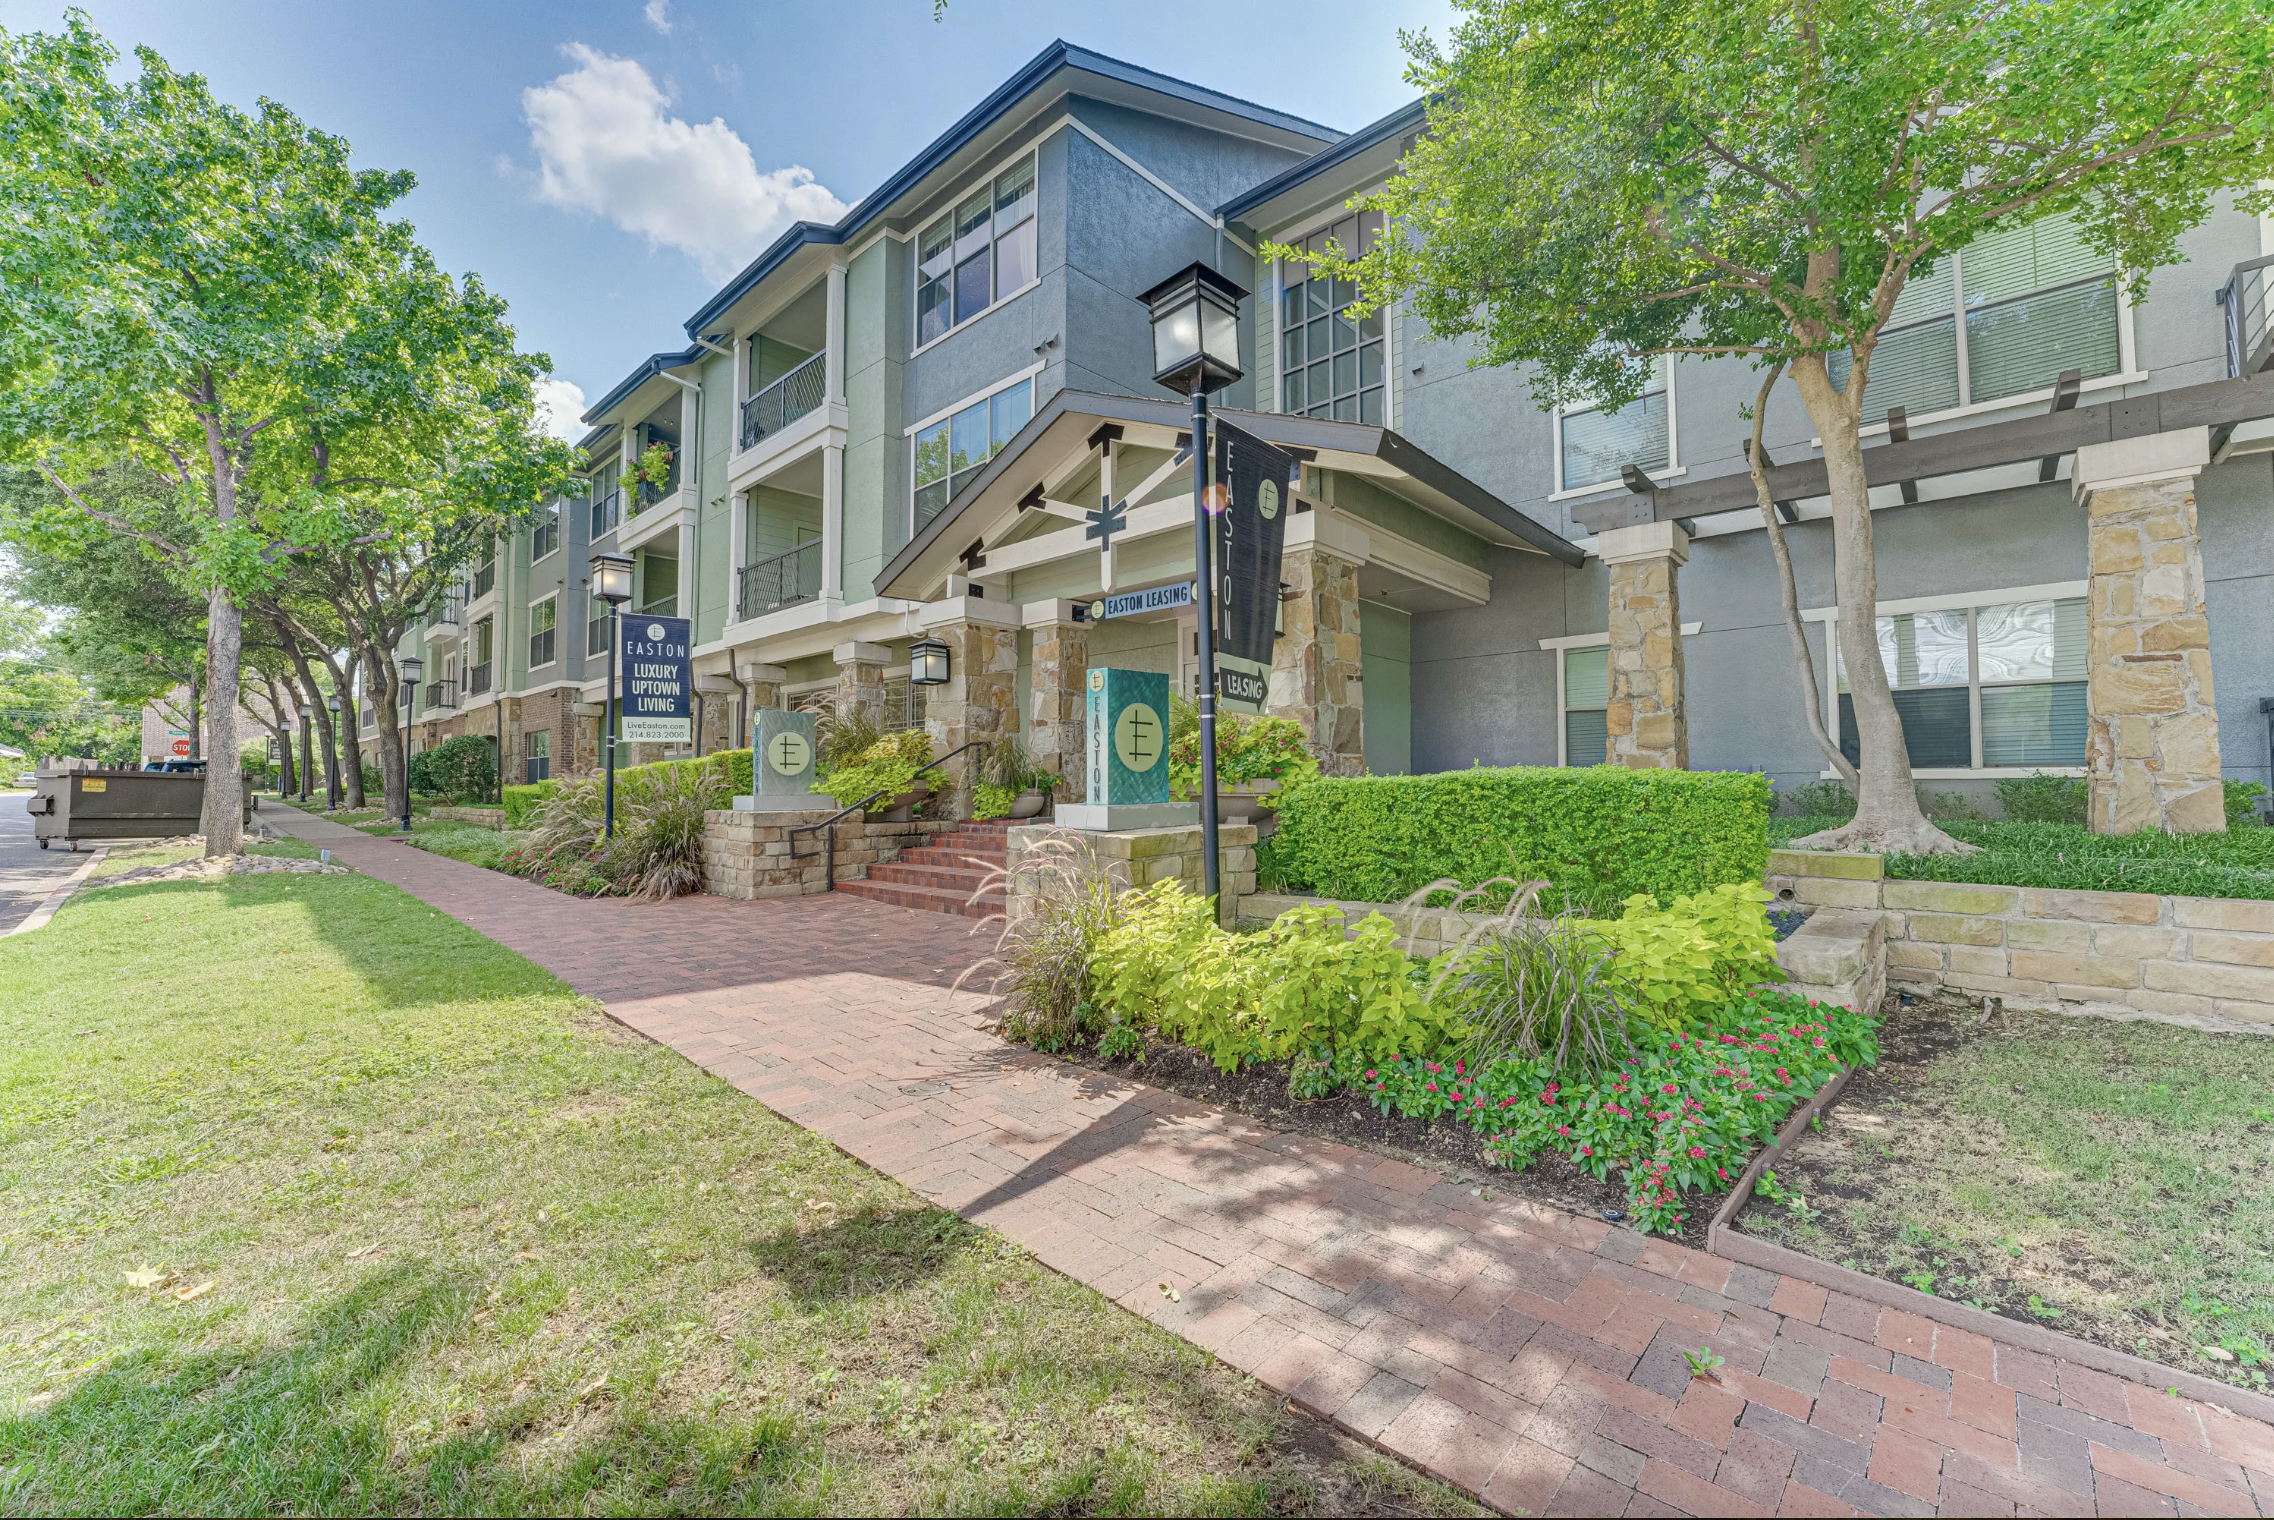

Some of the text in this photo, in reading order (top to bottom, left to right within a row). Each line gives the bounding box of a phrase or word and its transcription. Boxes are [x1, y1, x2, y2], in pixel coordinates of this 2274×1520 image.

[1224, 440, 1234, 641] EASTON
[1108, 586, 1188, 615] EASTON LEASING
[627, 641, 685, 657] EASTON
[634, 663, 679, 679] LUXURY
[632, 680, 680, 696] UPTOWN
[1227, 674, 1263, 699] LEASING
[638, 697, 675, 712] LIVING
[627, 721, 686, 730] LiveEaston.com
[629, 731, 685, 739] 214.823.2000
[1129, 709, 1154, 762] E
[780, 735, 801, 769] E
[1093, 696, 1101, 802] EASTON
